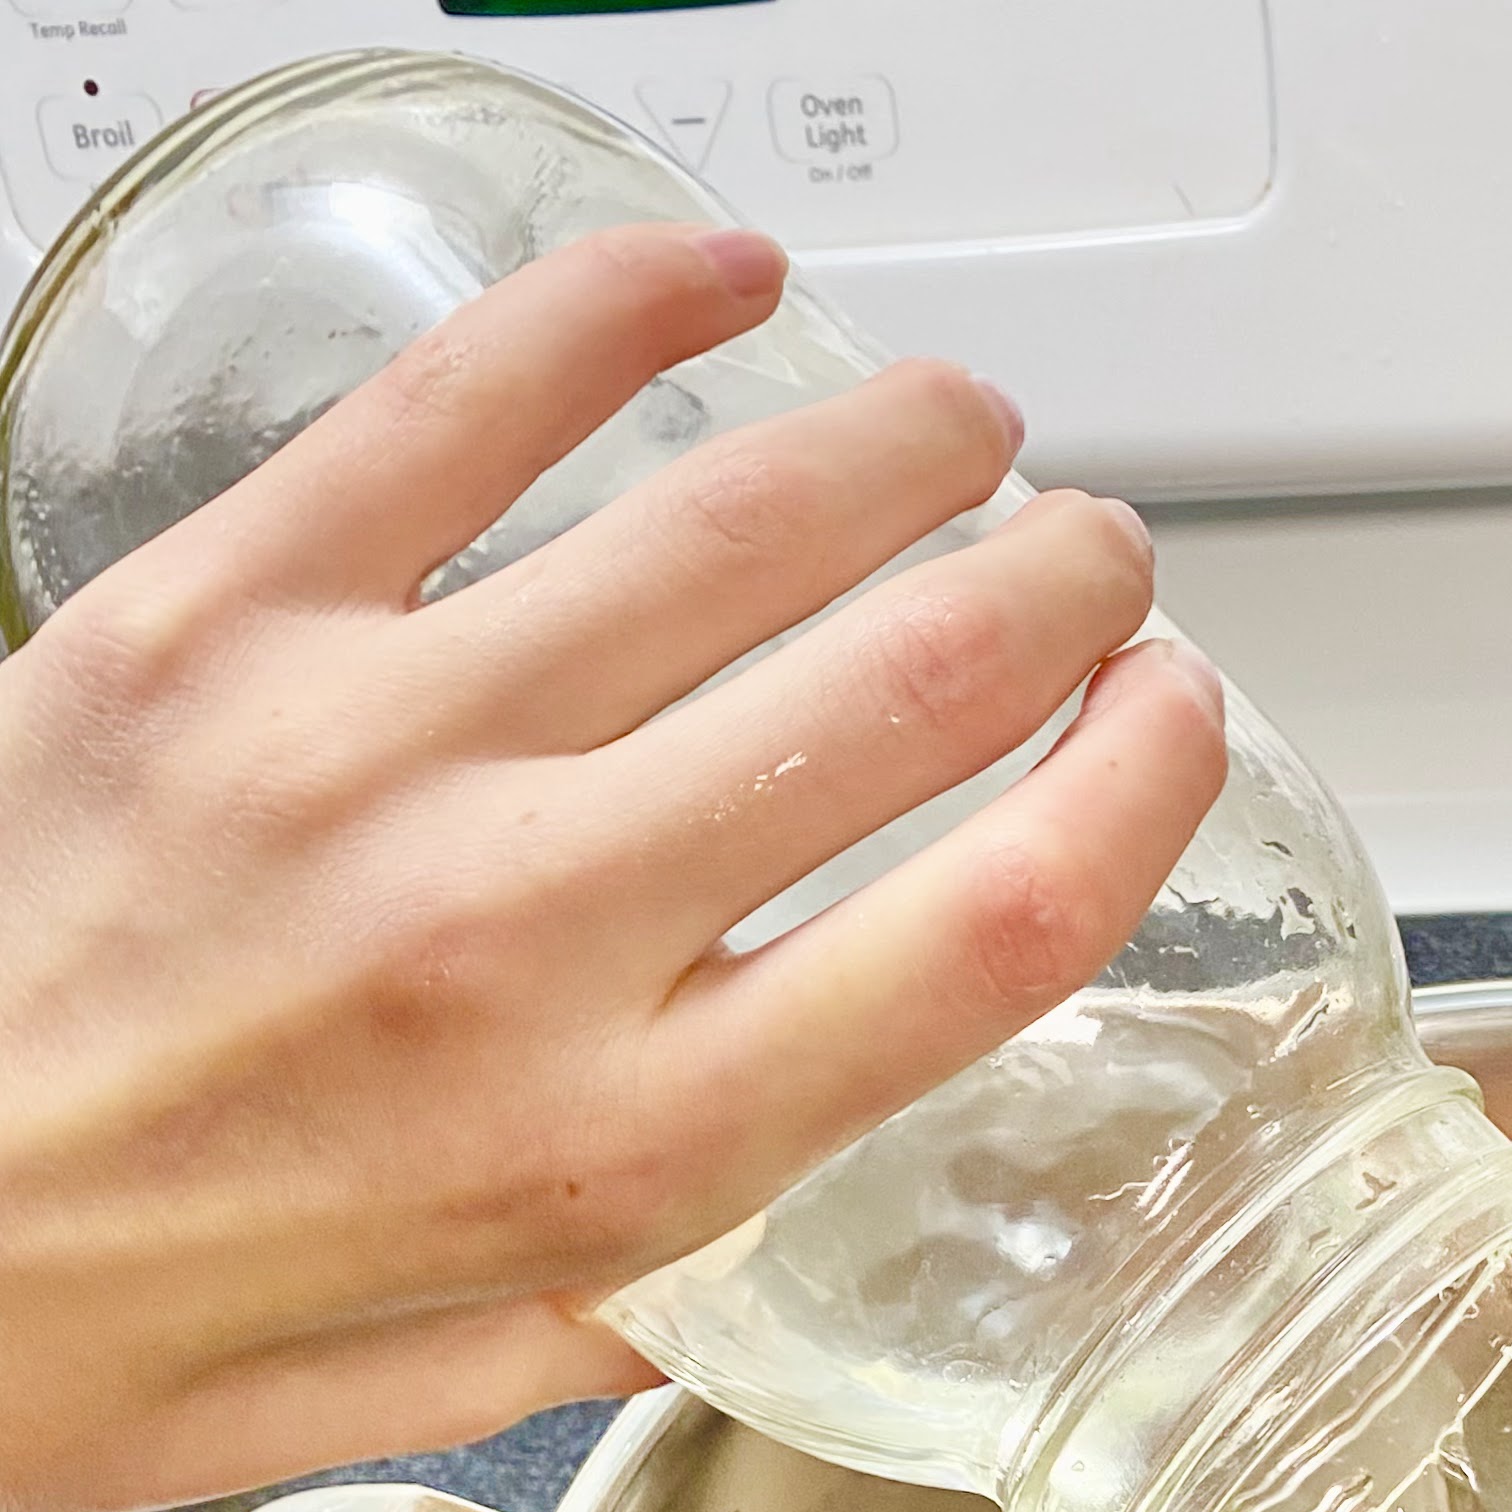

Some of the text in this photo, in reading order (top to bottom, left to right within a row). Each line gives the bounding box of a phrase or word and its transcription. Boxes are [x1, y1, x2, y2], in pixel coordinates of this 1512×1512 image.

[30, 18, 128, 39] Temp Recall
[800, 94, 865, 118] Oven
[72, 120, 135, 149] Broil
[804, 122, 868, 153] Light
